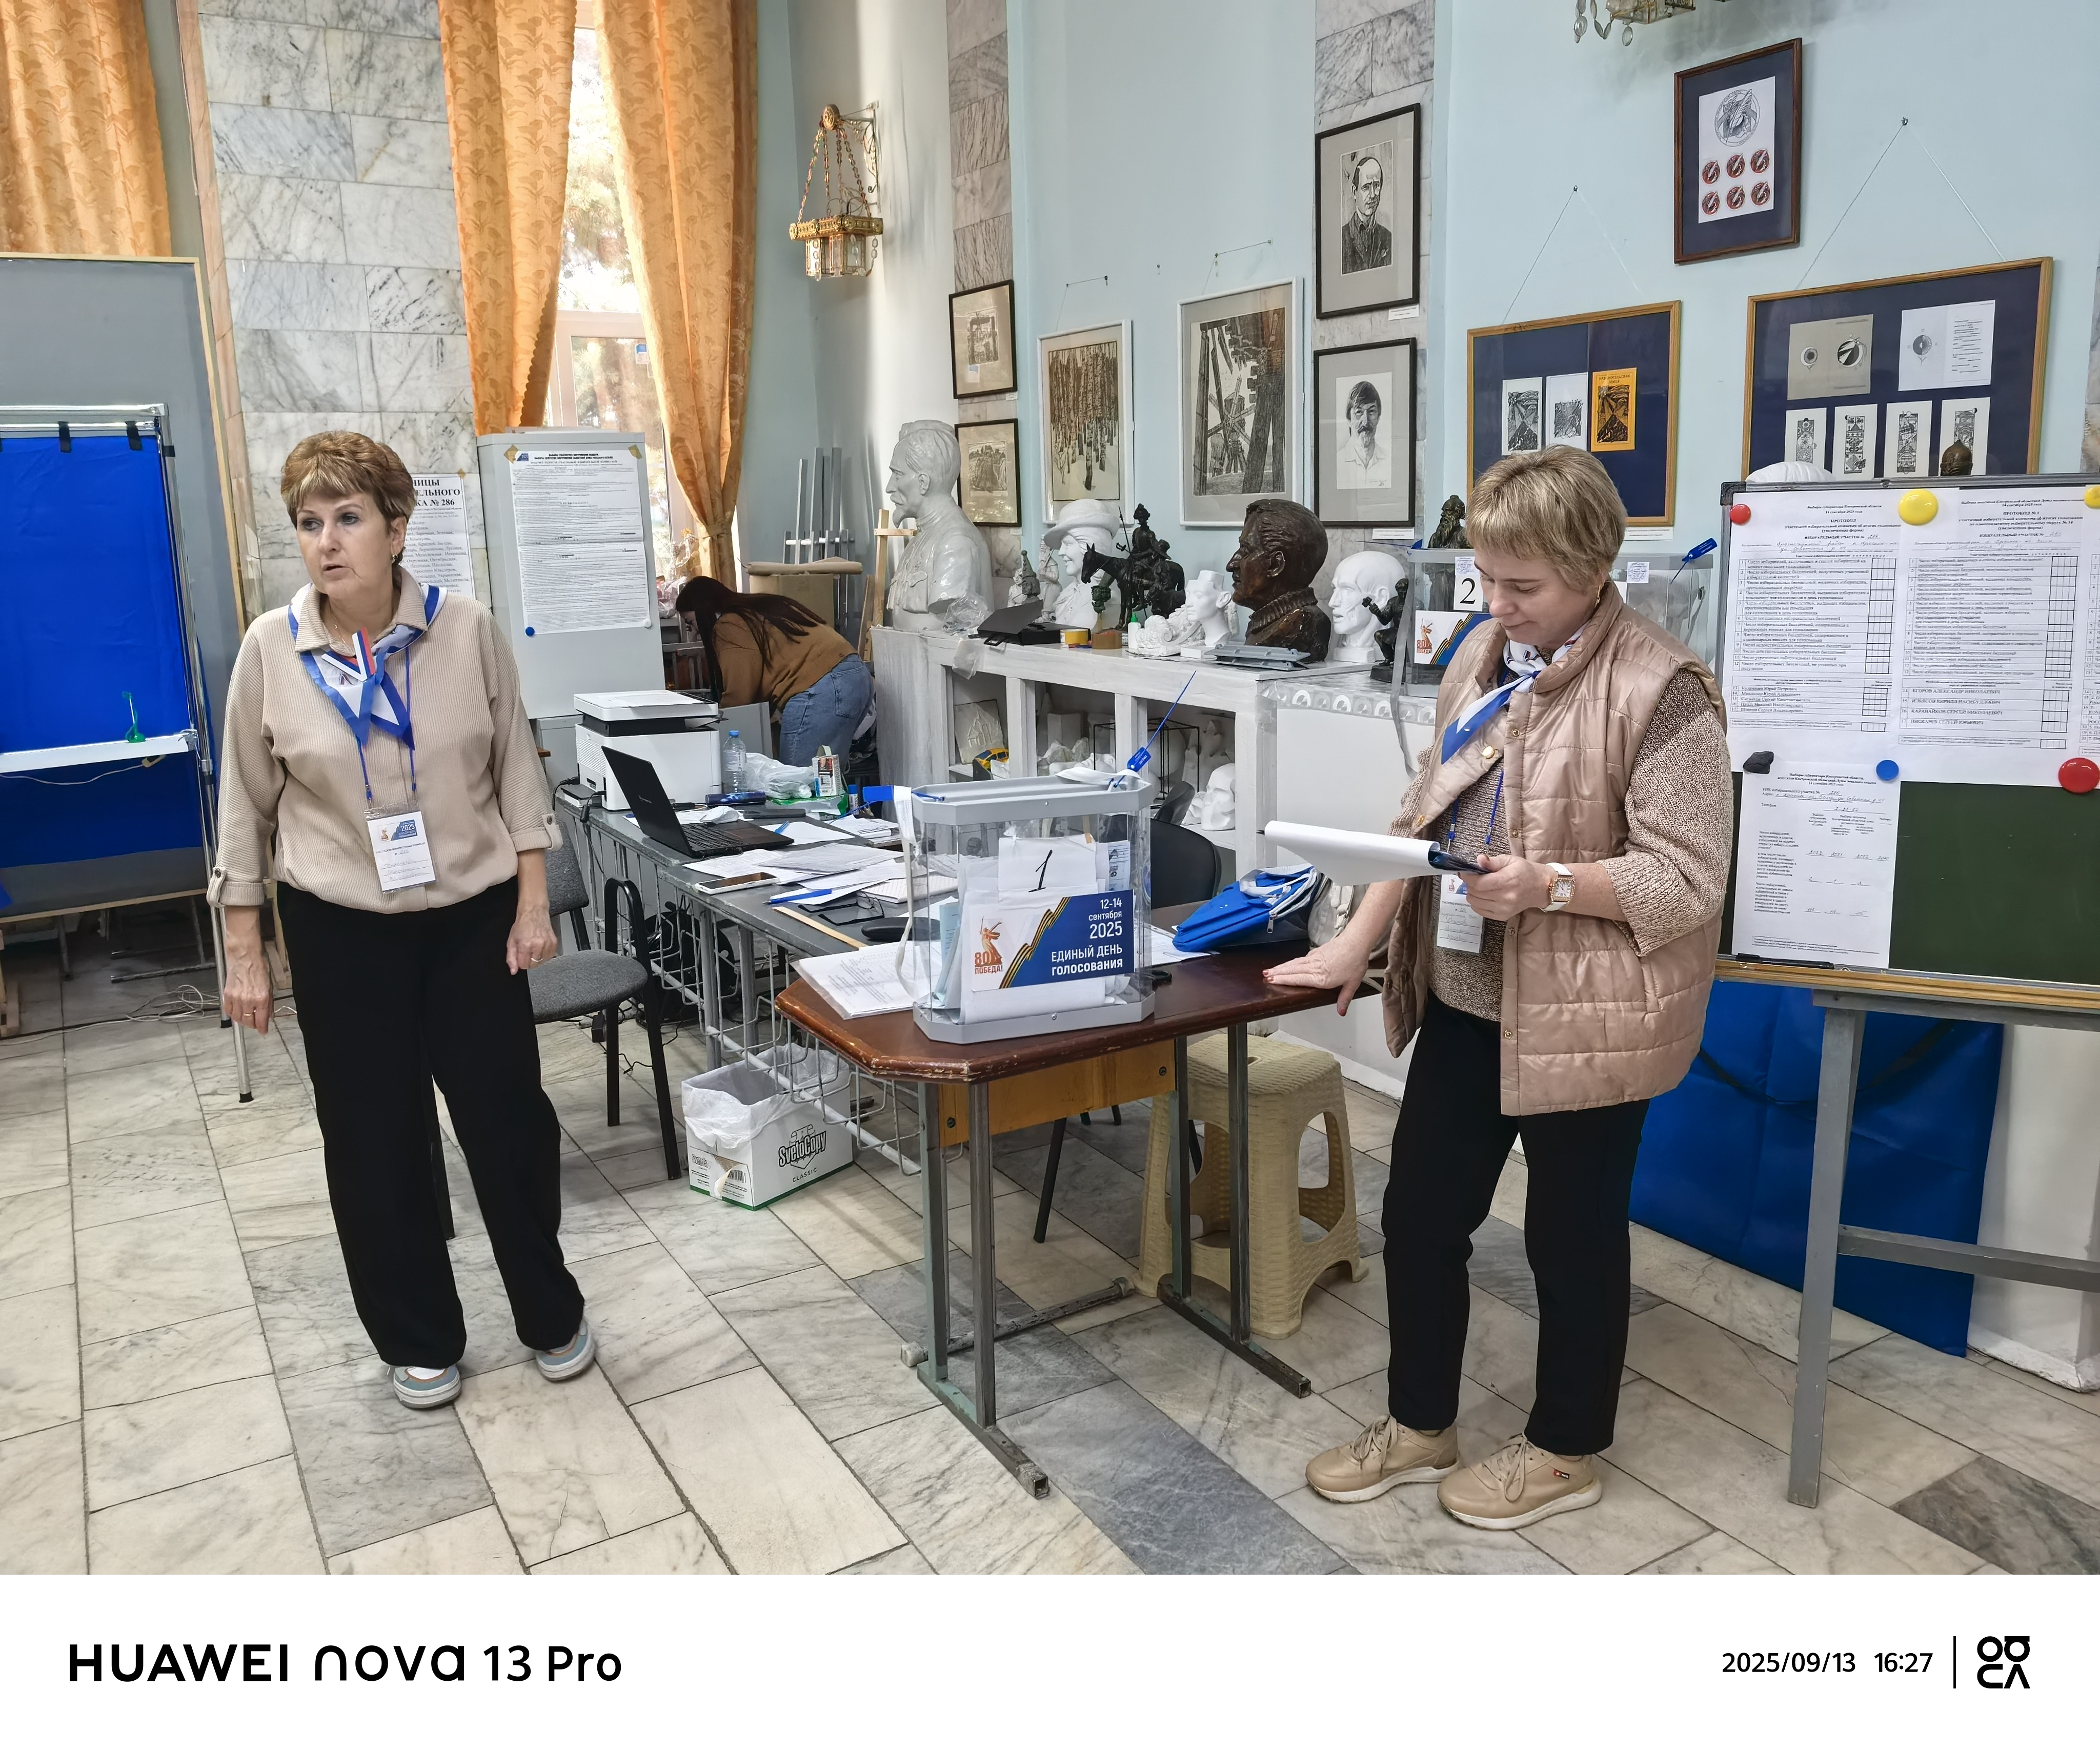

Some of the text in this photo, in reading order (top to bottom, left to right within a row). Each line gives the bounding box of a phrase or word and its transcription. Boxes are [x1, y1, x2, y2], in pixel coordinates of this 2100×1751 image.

[1460, 578, 1476, 604] 2
[1028, 849, 1053, 892] 1
[1100, 898, 1122, 910] 12-14
[1088, 910, 1122, 921] сентября
[1089, 921, 1123, 939] 2025
[975, 952, 989, 965] 80
[1051, 944, 1123, 962] ЕДИНЫЙ ДЕНЬ
[975, 964, 1003, 974] ПОБЕДА!
[1052, 959, 1123, 975] голосования
[778, 1131, 826, 1167] SvetoCopy
[792, 1167, 817, 1183] CLASSIC
